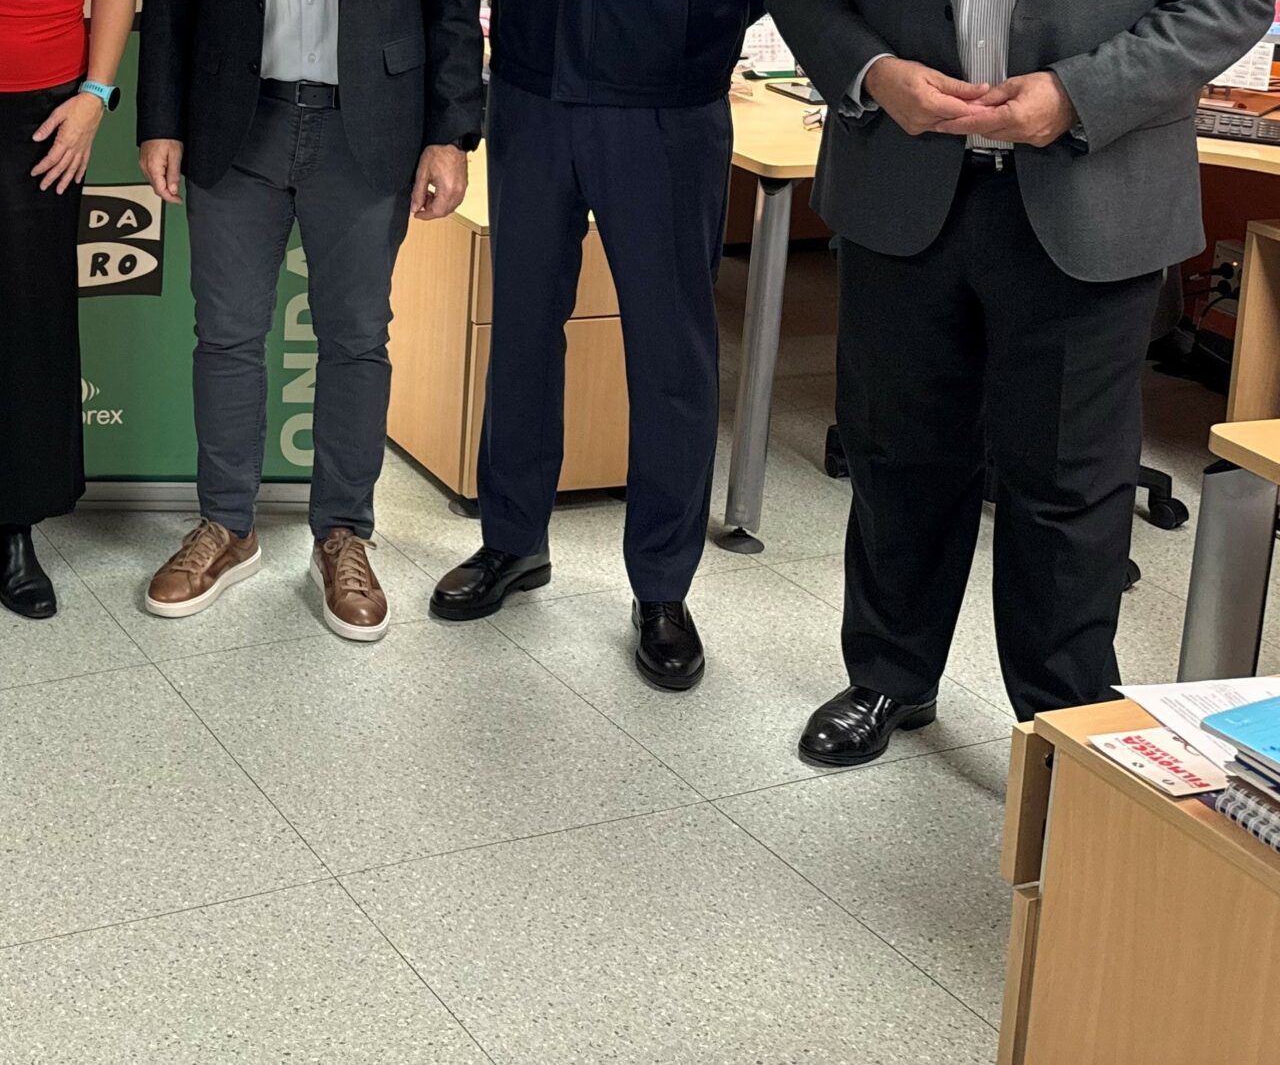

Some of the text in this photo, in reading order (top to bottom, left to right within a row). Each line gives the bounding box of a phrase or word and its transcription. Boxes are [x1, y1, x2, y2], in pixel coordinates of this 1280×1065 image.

[89, 208, 138, 229] DA
[90, 252, 138, 278] RO
[1122, 736, 1213, 789] FILMOTECA
